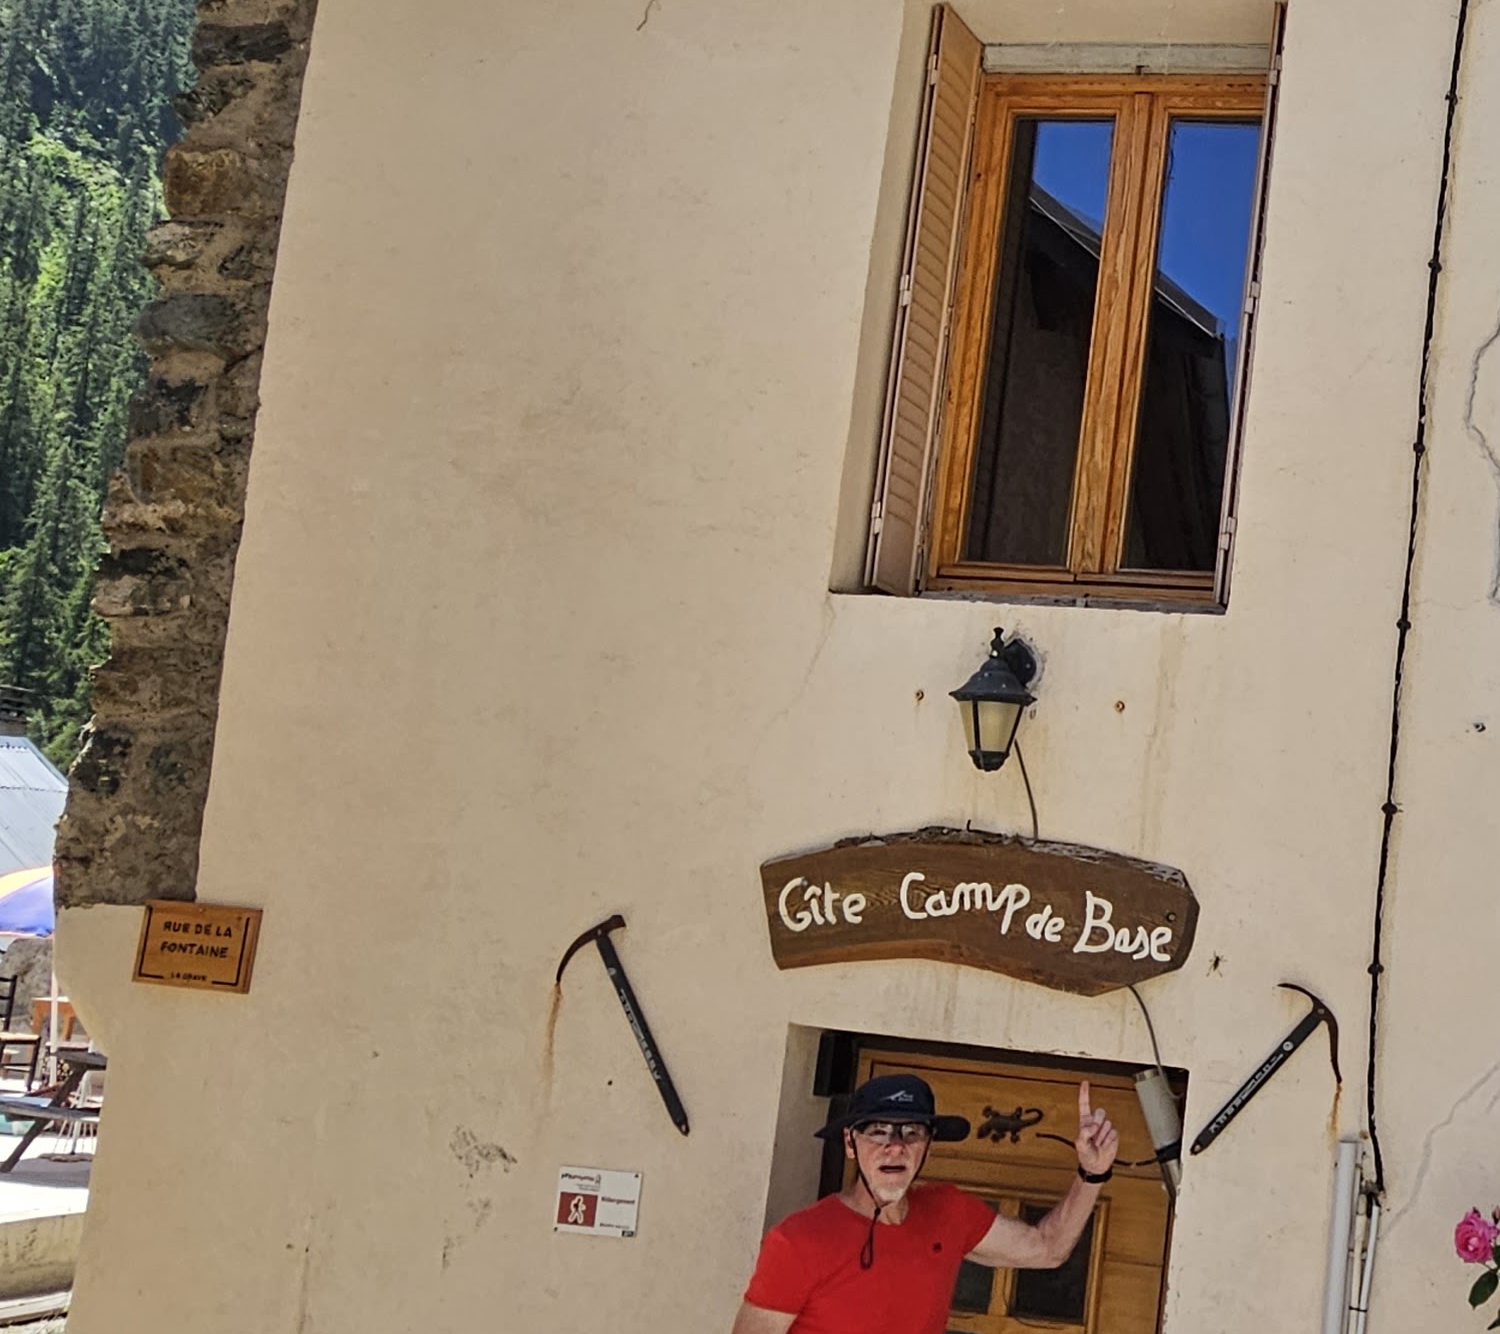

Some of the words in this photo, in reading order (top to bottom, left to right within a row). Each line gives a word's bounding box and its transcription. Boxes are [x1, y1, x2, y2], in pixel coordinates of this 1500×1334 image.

[778, 876, 866, 932] Gîte
[900, 871, 1031, 935] Camp
[1025, 904, 1065, 942] de
[1073, 890, 1172, 961] Base
[163, 921, 191, 933] RUE
[194, 923, 212, 936] DE
[215, 926, 232, 938] LA
[160, 941, 229, 959] FONTAINE
